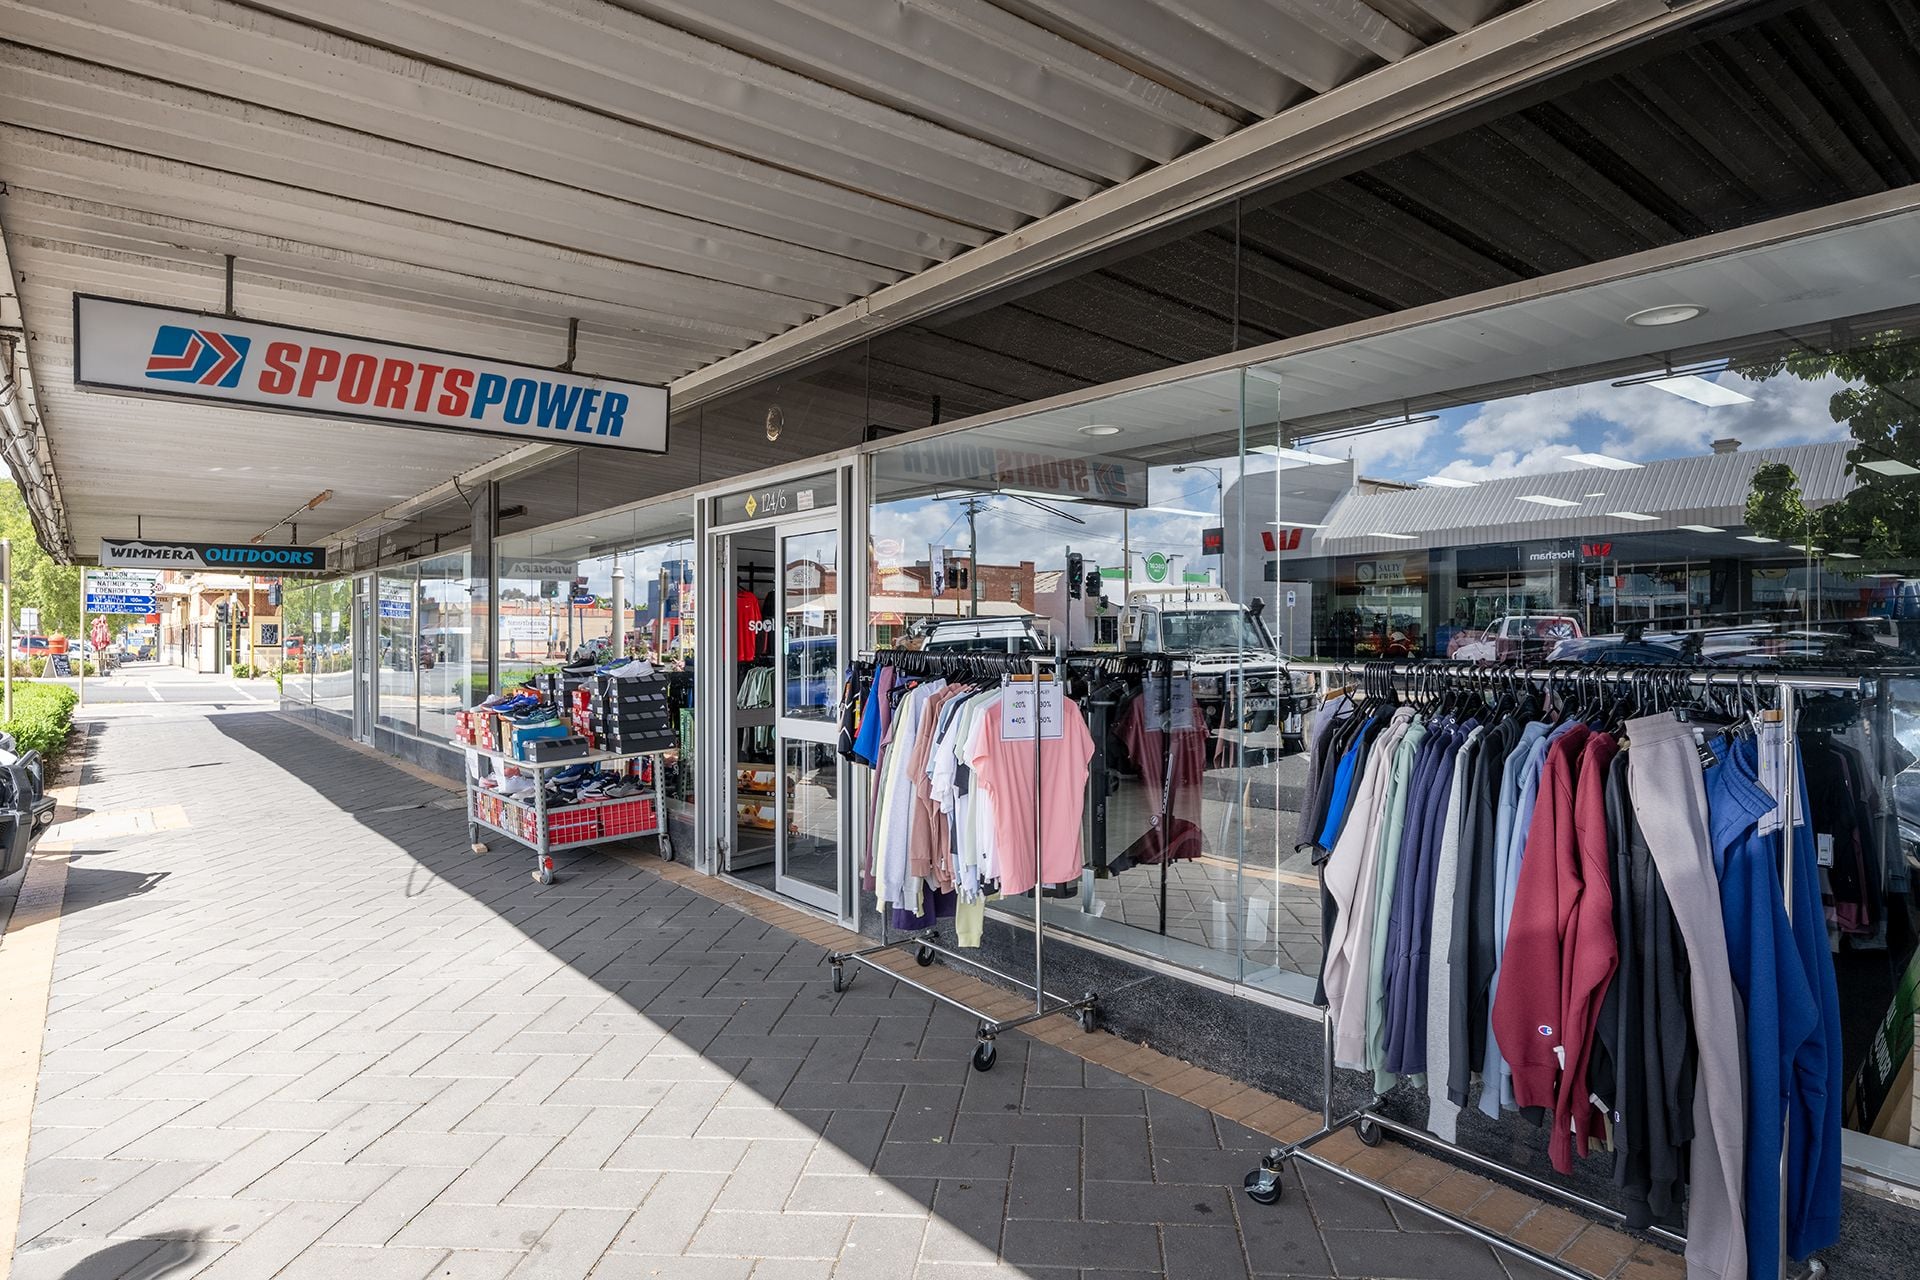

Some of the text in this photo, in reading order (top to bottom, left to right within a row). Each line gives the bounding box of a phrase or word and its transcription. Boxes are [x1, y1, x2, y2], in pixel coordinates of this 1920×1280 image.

[258, 341, 630, 438] SPORTSPOWER
[110, 547, 314, 565] WIMMERA OUTDOORS
[1378, 563, 1401, 573] SALTY
[1379, 572, 1400, 580] CREW
